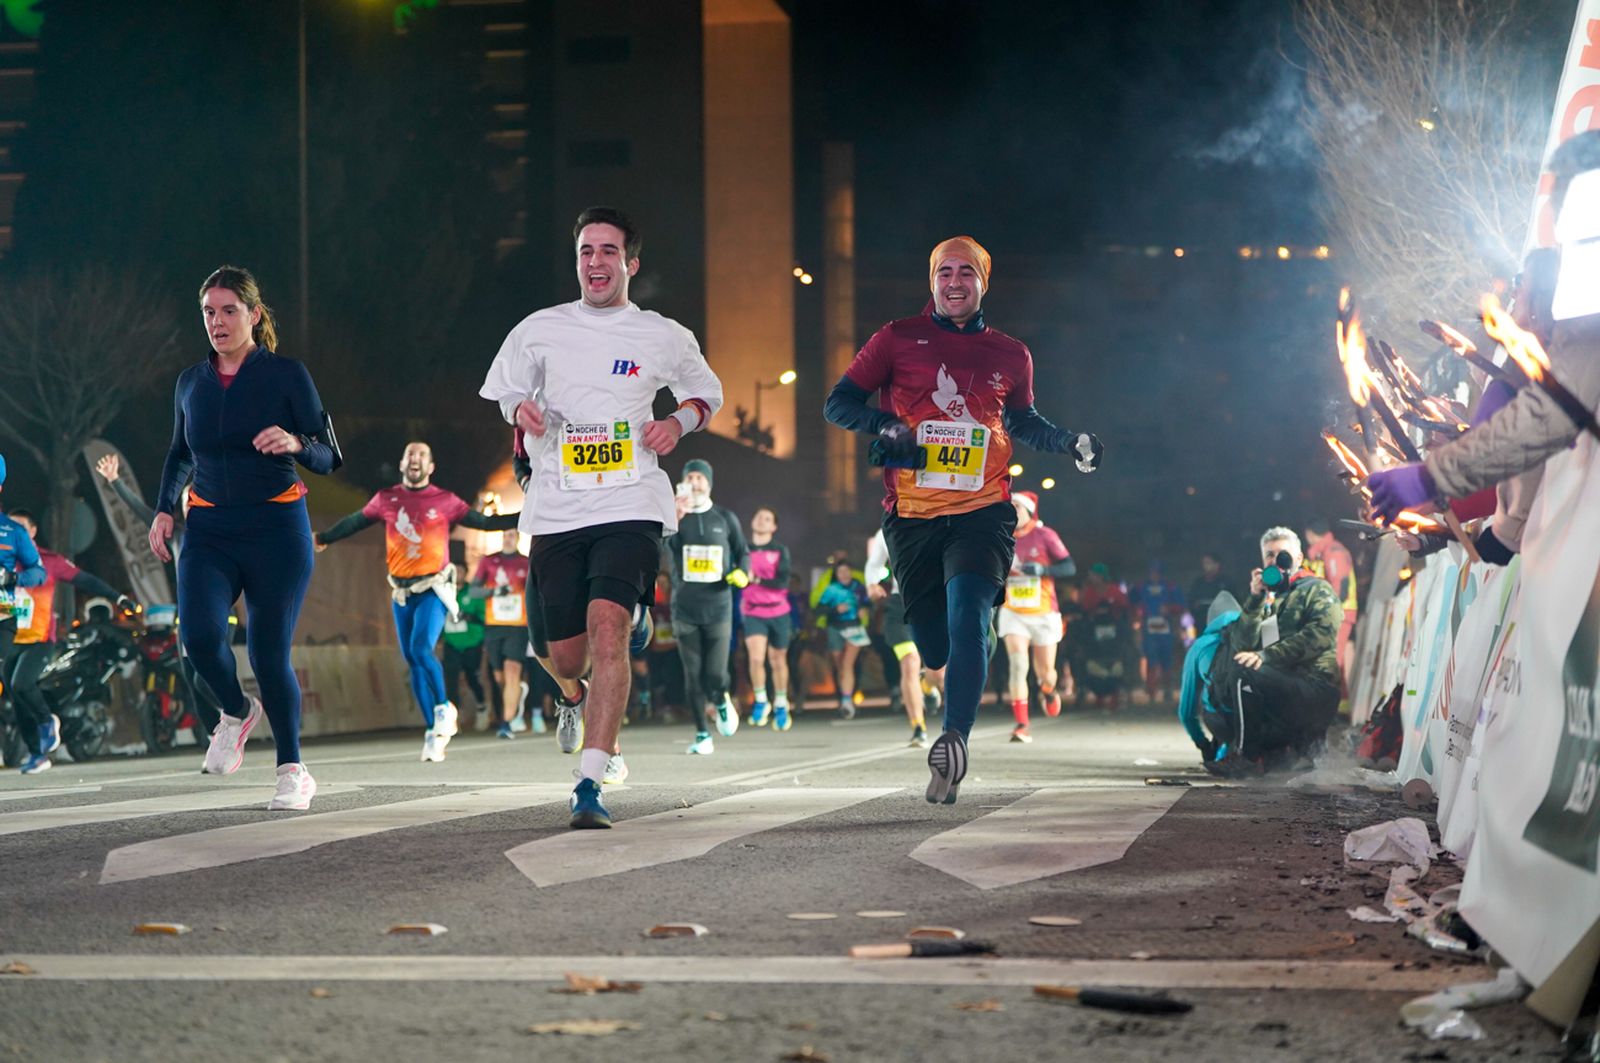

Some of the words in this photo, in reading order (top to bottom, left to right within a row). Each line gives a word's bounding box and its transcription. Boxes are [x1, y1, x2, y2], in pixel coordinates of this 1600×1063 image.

[946, 400, 964, 417] 43
[575, 426, 598, 434] NOCHE
[934, 428, 956, 436] NOCHE
[567, 435, 582, 443] SAN
[925, 436, 940, 444] SAN
[573, 441, 623, 465] 3266
[937, 446, 971, 467] 447
